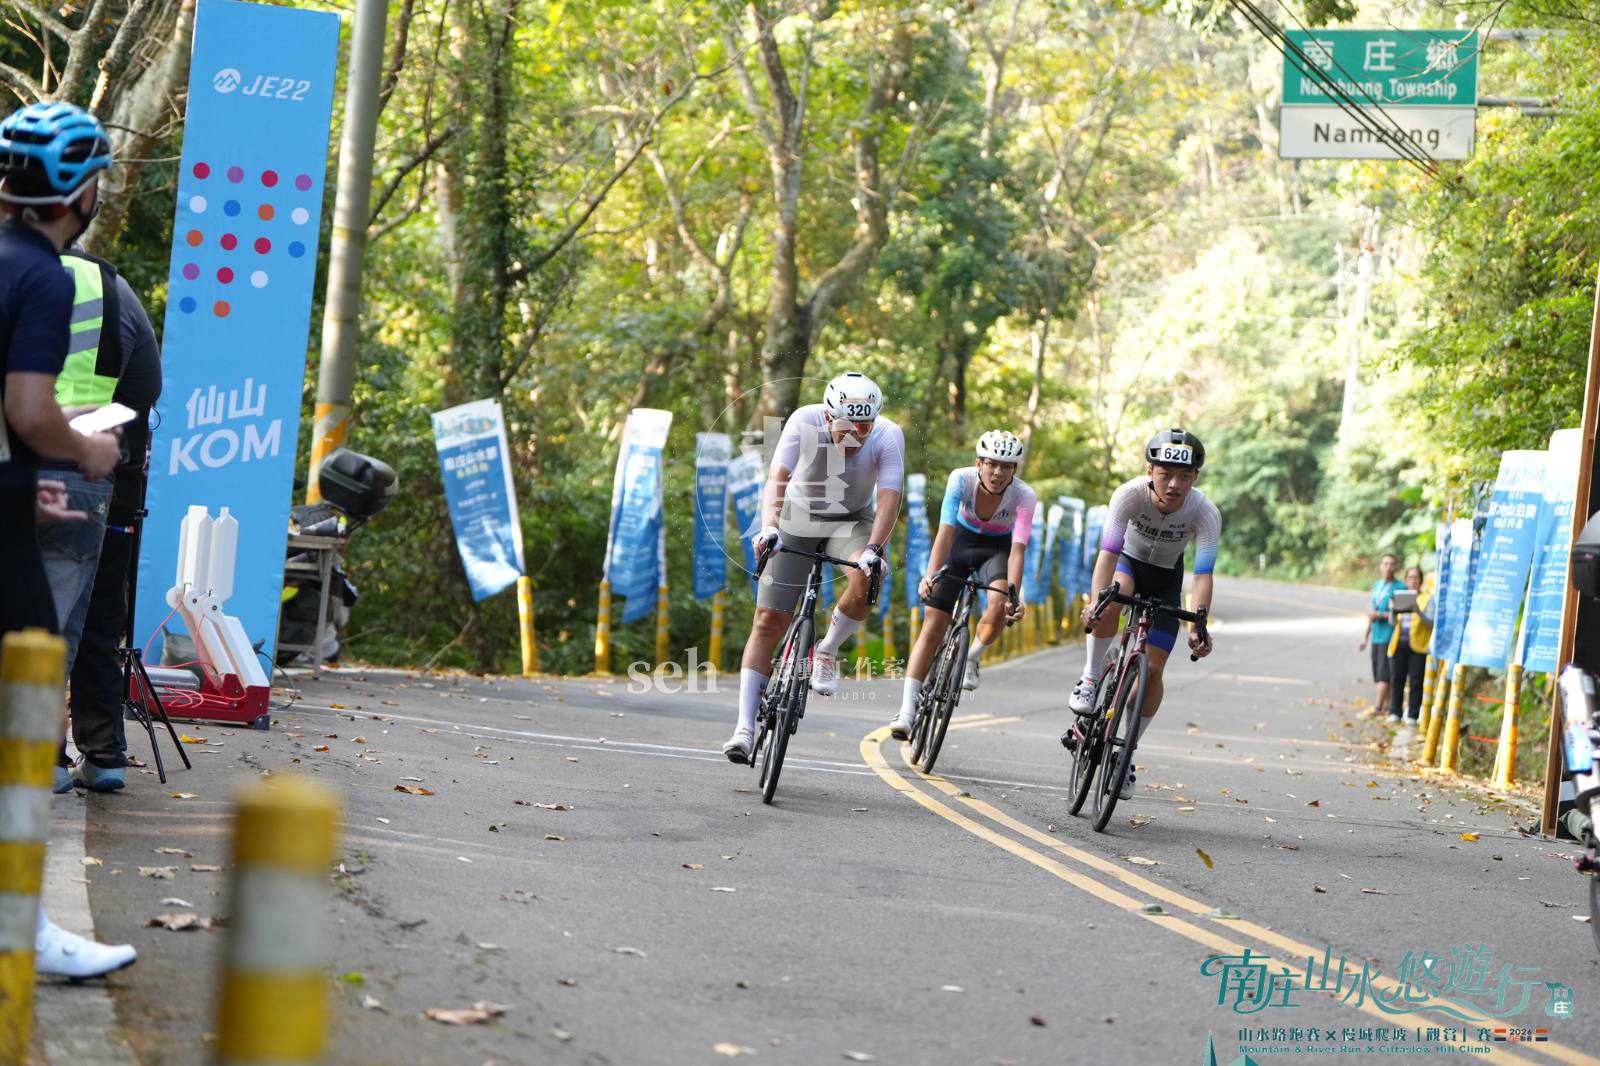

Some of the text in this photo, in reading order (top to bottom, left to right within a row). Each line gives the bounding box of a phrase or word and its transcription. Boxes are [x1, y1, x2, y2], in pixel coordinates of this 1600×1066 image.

[1302, 39, 1459, 71] 南庄鄉
[242, 75, 311, 101] JE22
[1389, 79, 1457, 97] Township
[1313, 123, 1440, 150] Namzong
[185, 378, 267, 430] 仙山
[847, 404, 871, 417] 320
[168, 419, 282, 476] KOM
[993, 438, 1014, 451] 611
[1164, 447, 1189, 462] 620
